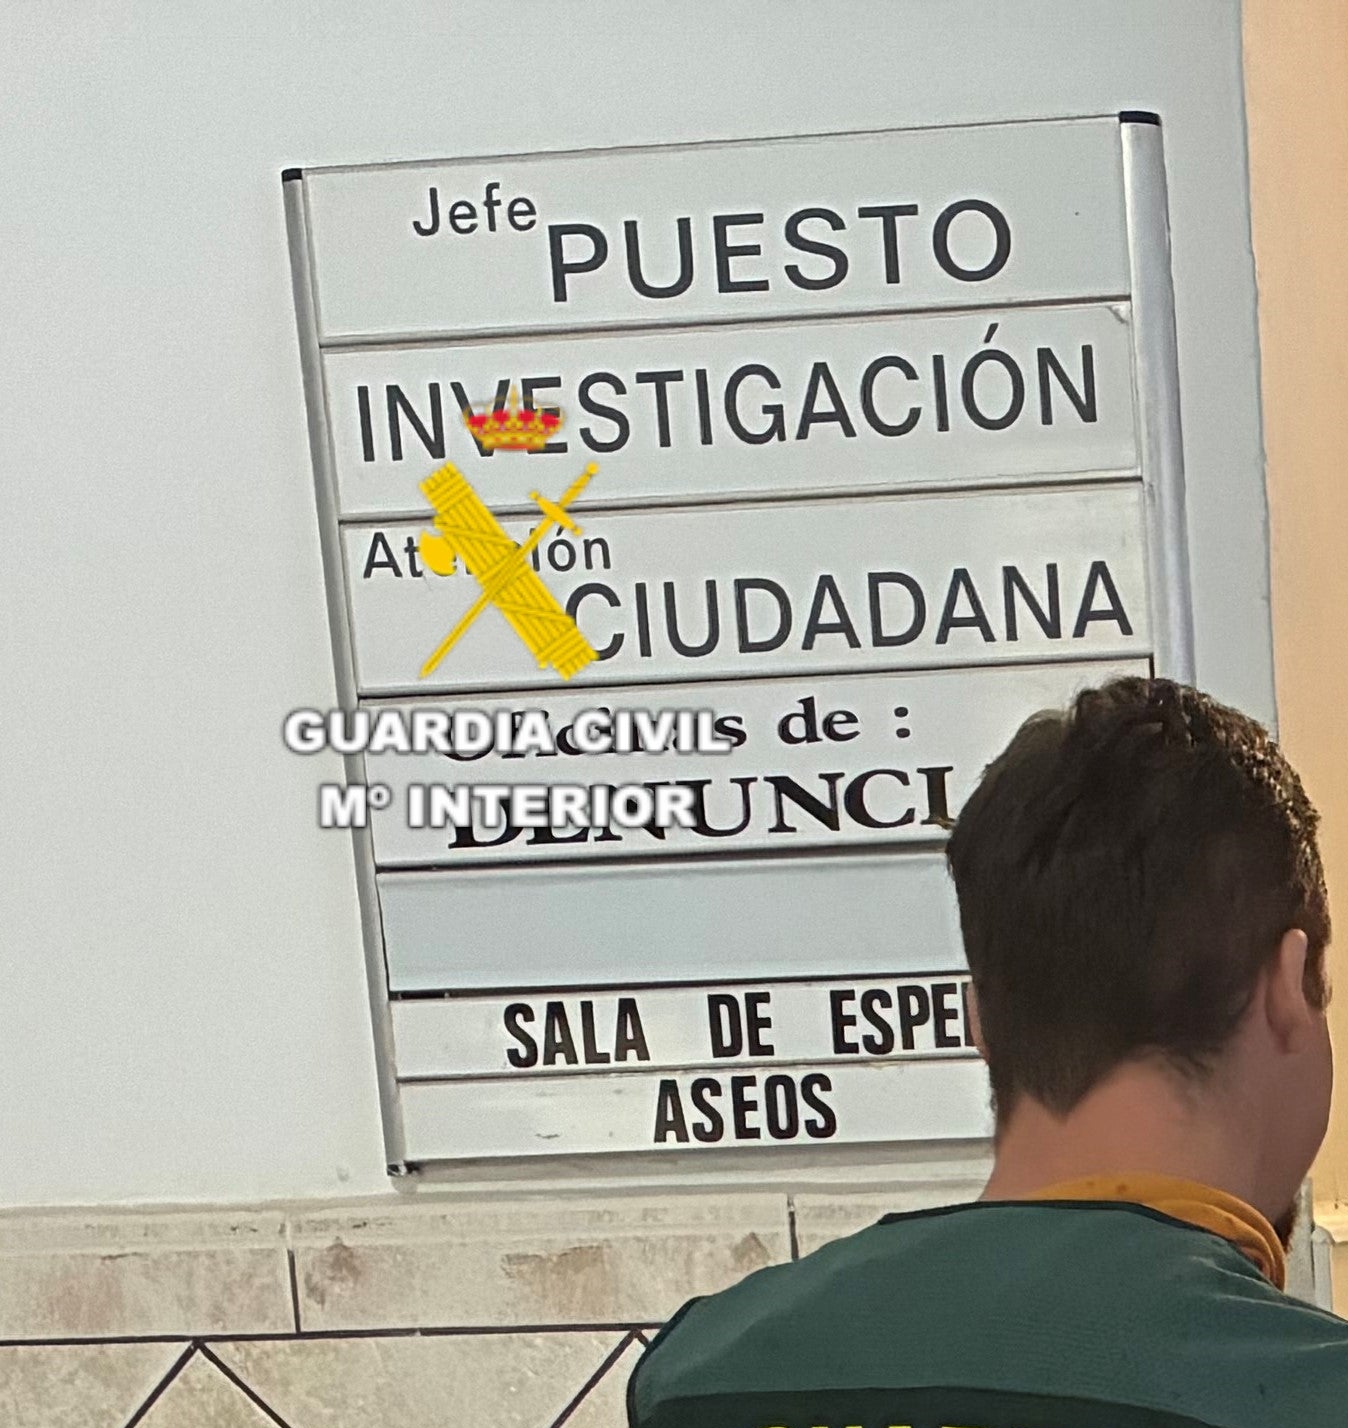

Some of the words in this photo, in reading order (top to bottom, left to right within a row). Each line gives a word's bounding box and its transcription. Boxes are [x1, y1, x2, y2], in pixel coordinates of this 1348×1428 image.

[413, 182, 537, 237] Jefe
[547, 199, 1012, 302] PUESTO
[357, 323, 1099, 462] INVESTIGACIÓN
[565, 560, 1134, 662] CIUDADANA
[777, 695, 861, 745] de
[504, 997, 651, 1068] SALA
[707, 990, 775, 1059] DE
[830, 982, 974, 1056] ESPE
[654, 1072, 837, 1144] ASEOS
